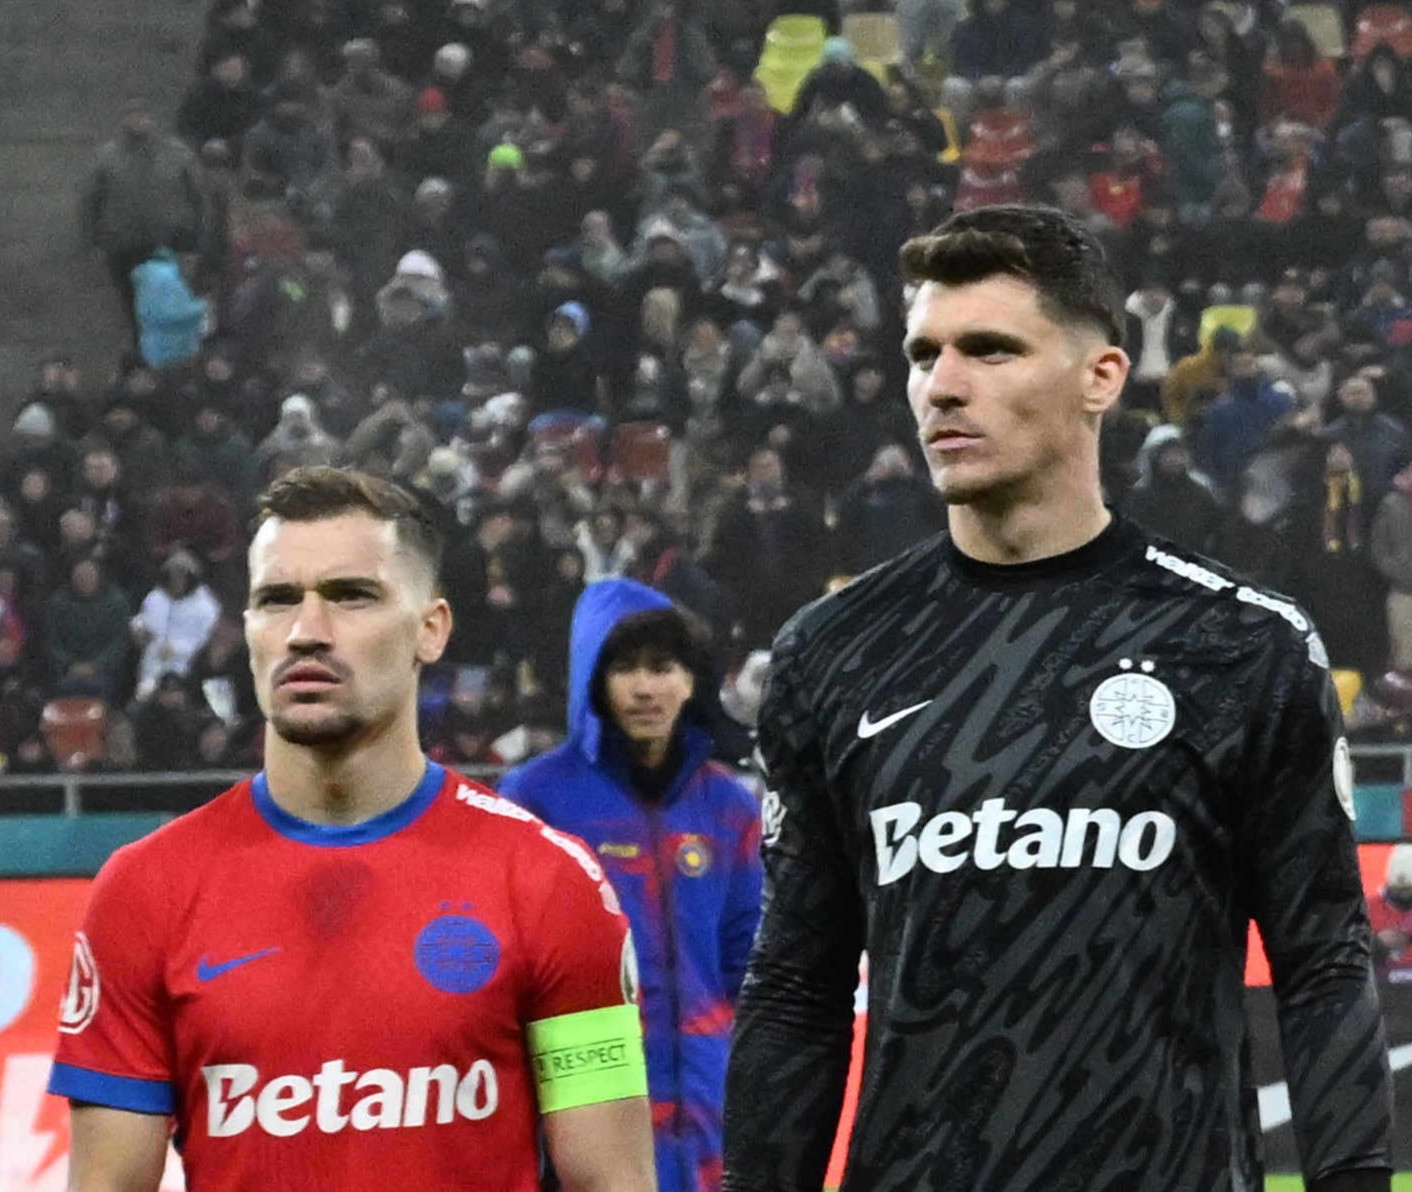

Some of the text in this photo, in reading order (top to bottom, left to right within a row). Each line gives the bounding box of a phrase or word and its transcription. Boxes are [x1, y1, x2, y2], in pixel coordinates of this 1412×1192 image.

[869, 796, 1177, 887] Betano
[201, 1058, 499, 1138] Betano
[552, 1044, 626, 1072] RESPECT
